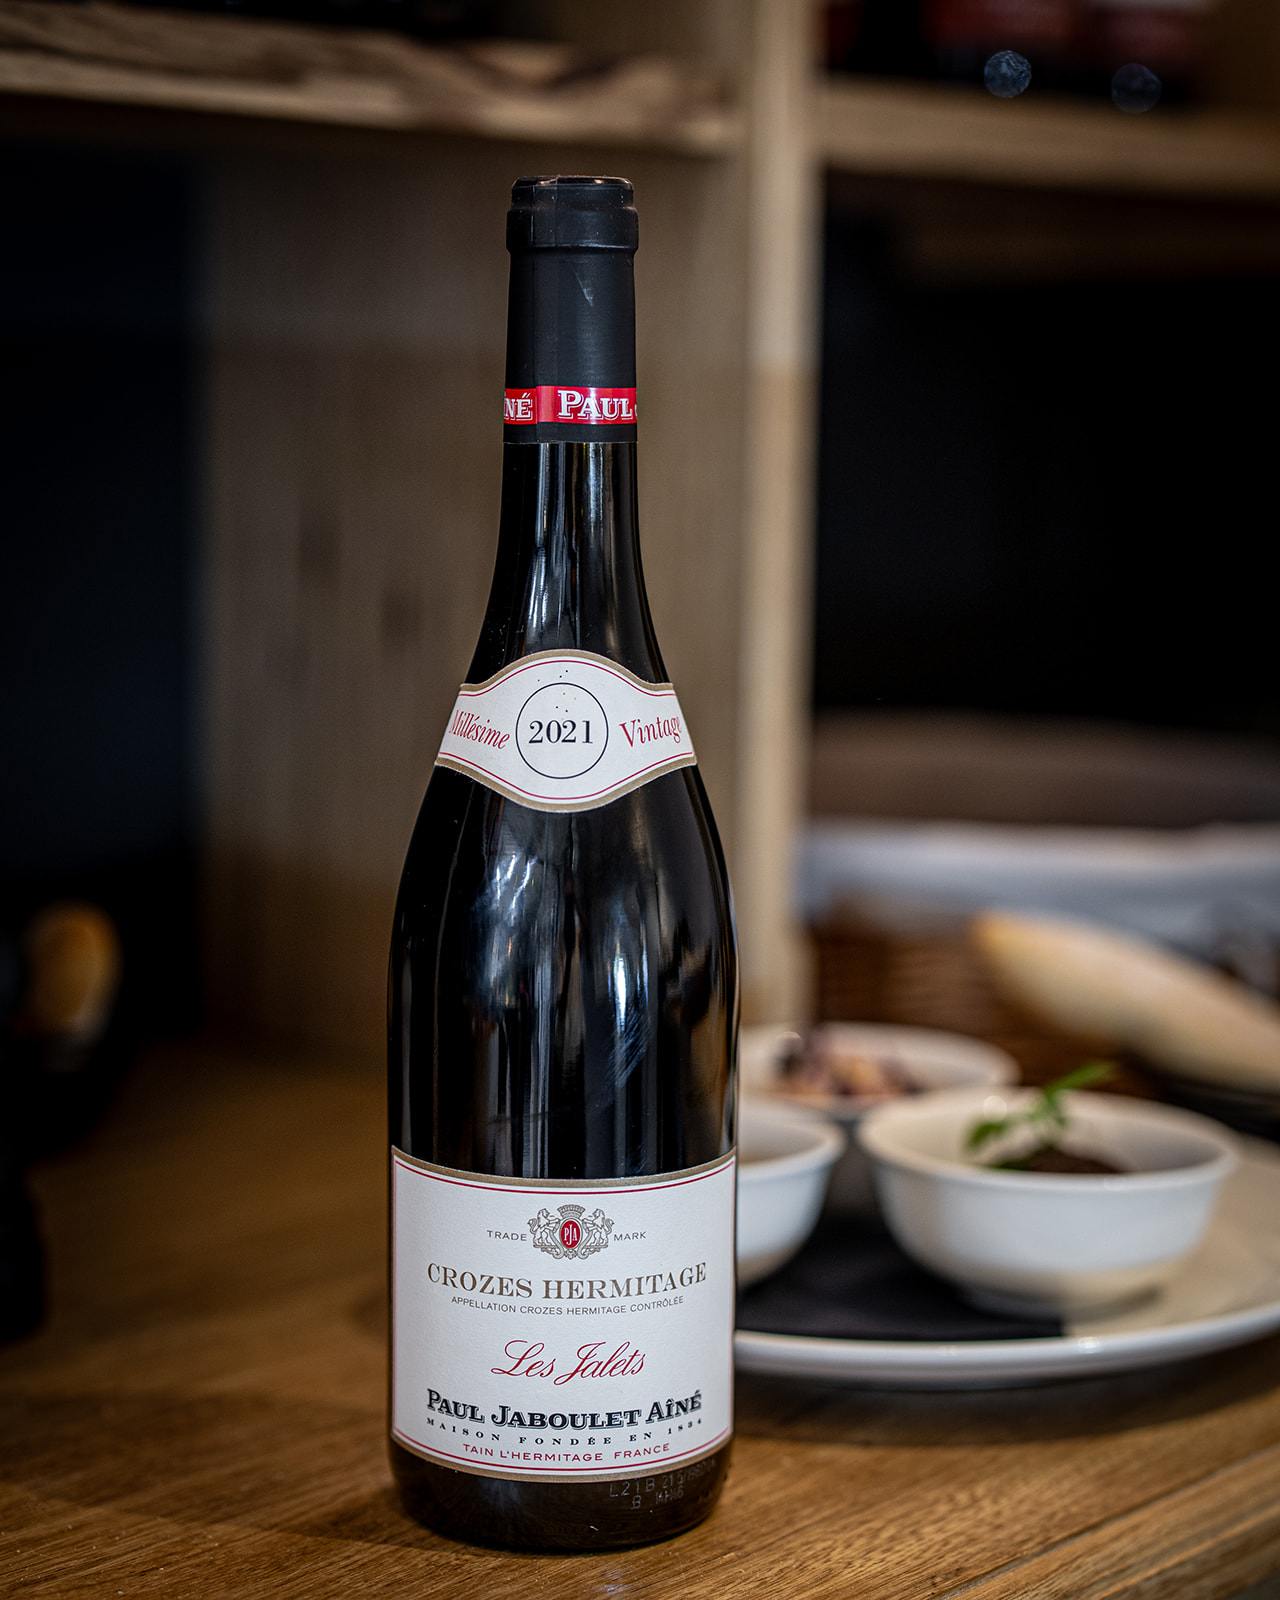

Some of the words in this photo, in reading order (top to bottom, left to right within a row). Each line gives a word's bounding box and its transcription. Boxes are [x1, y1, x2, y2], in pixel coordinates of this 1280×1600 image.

[504, 392, 533, 420] NÉ
[557, 390, 633, 420] PAUL
[448, 709, 510, 750] Millésime
[528, 720, 593, 744] 2021
[487, 1230, 527, 1242] TRADE
[613, 1231, 647, 1241] MARK
[563, 1224, 578, 1246] PJA
[427, 1262, 533, 1298] CROZES
[541, 1262, 707, 1299] HERMITAGE
[451, 1296, 517, 1313] APPELLATION
[520, 1307, 564, 1315] CROZES
[566, 1304, 627, 1315] HERMITAGE
[630, 1295, 684, 1313] CONTRÔLÉE
[490, 1340, 556, 1378] Les
[553, 1341, 646, 1386] Jalets
[426, 1389, 485, 1423] PAUL
[490, 1406, 642, 1431] JABOULET
[645, 1389, 702, 1424] AÎNÉ
[426, 1417, 501, 1441] MAISON
[518, 1436, 612, 1446] FONDÉE
[629, 1431, 652, 1442] EN
[668, 1418, 702, 1435] 1834
[462, 1443, 494, 1458] TAIN
[500, 1450, 603, 1462] L'HERMITAGE
[614, 1443, 670, 1460] FRANCE
